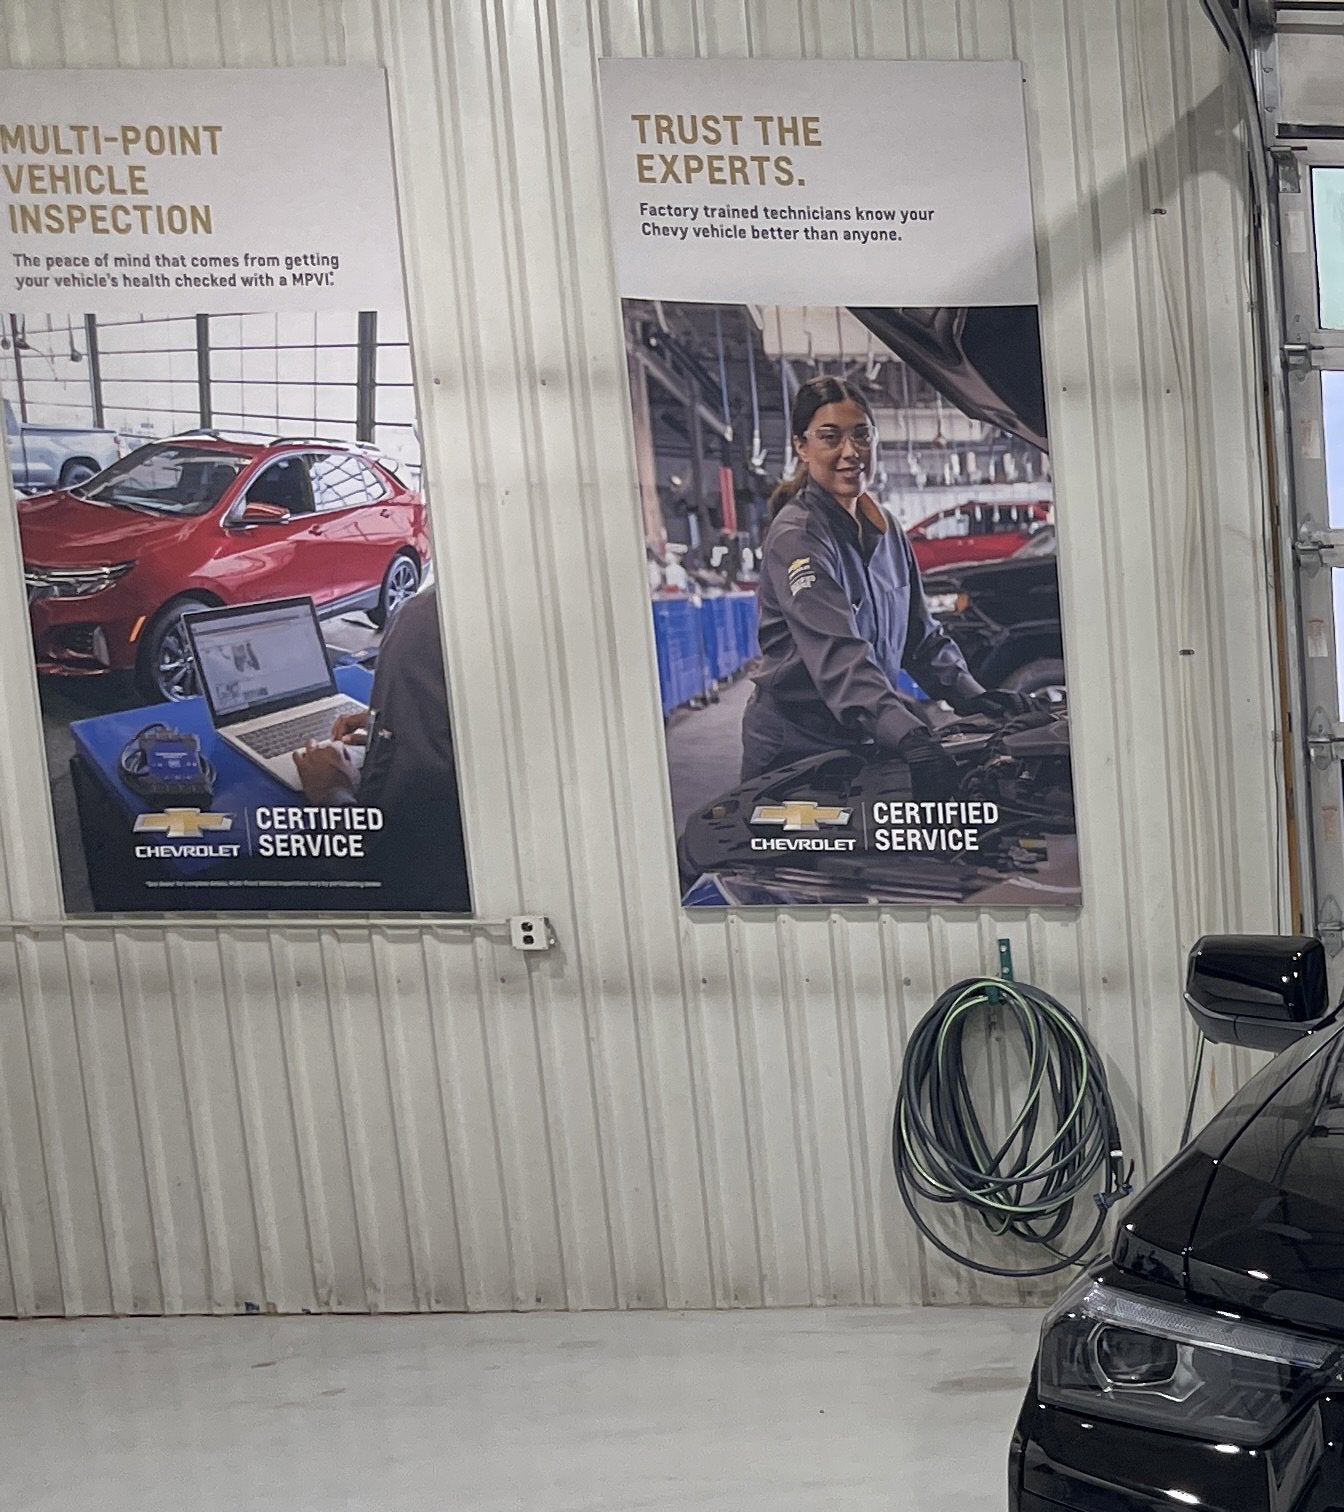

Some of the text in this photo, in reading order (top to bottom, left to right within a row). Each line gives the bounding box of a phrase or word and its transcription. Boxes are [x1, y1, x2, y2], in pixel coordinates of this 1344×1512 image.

[0, 124, 223, 156] MULTI-POINT
[631, 114, 822, 147] TRUST THE
[2, 164, 149, 196] VEHICLE
[636, 153, 806, 186] EXPERTS.
[9, 203, 213, 235] INSPECTION
[639, 202, 935, 225] Factory trained technicians know your
[641, 222, 903, 244] Chevy vehicle better than anyone.
[13, 253, 340, 271] The peace of mind that comes from getting
[16, 276, 50, 290] your
[54, 273, 119, 288] vehicle's
[123, 273, 171, 288] health
[175, 273, 237, 288] checked
[241, 273, 274, 287] with
[279, 276, 287, 287] a
[256, 807, 383, 831] CERTIFIED
[873, 802, 999, 825] CERTIFIED
[135, 845, 240, 858] CHEVROLET
[258, 834, 364, 857] SERVICE
[751, 838, 856, 851] CHEVROLET
[875, 829, 979, 851] SERVICE
